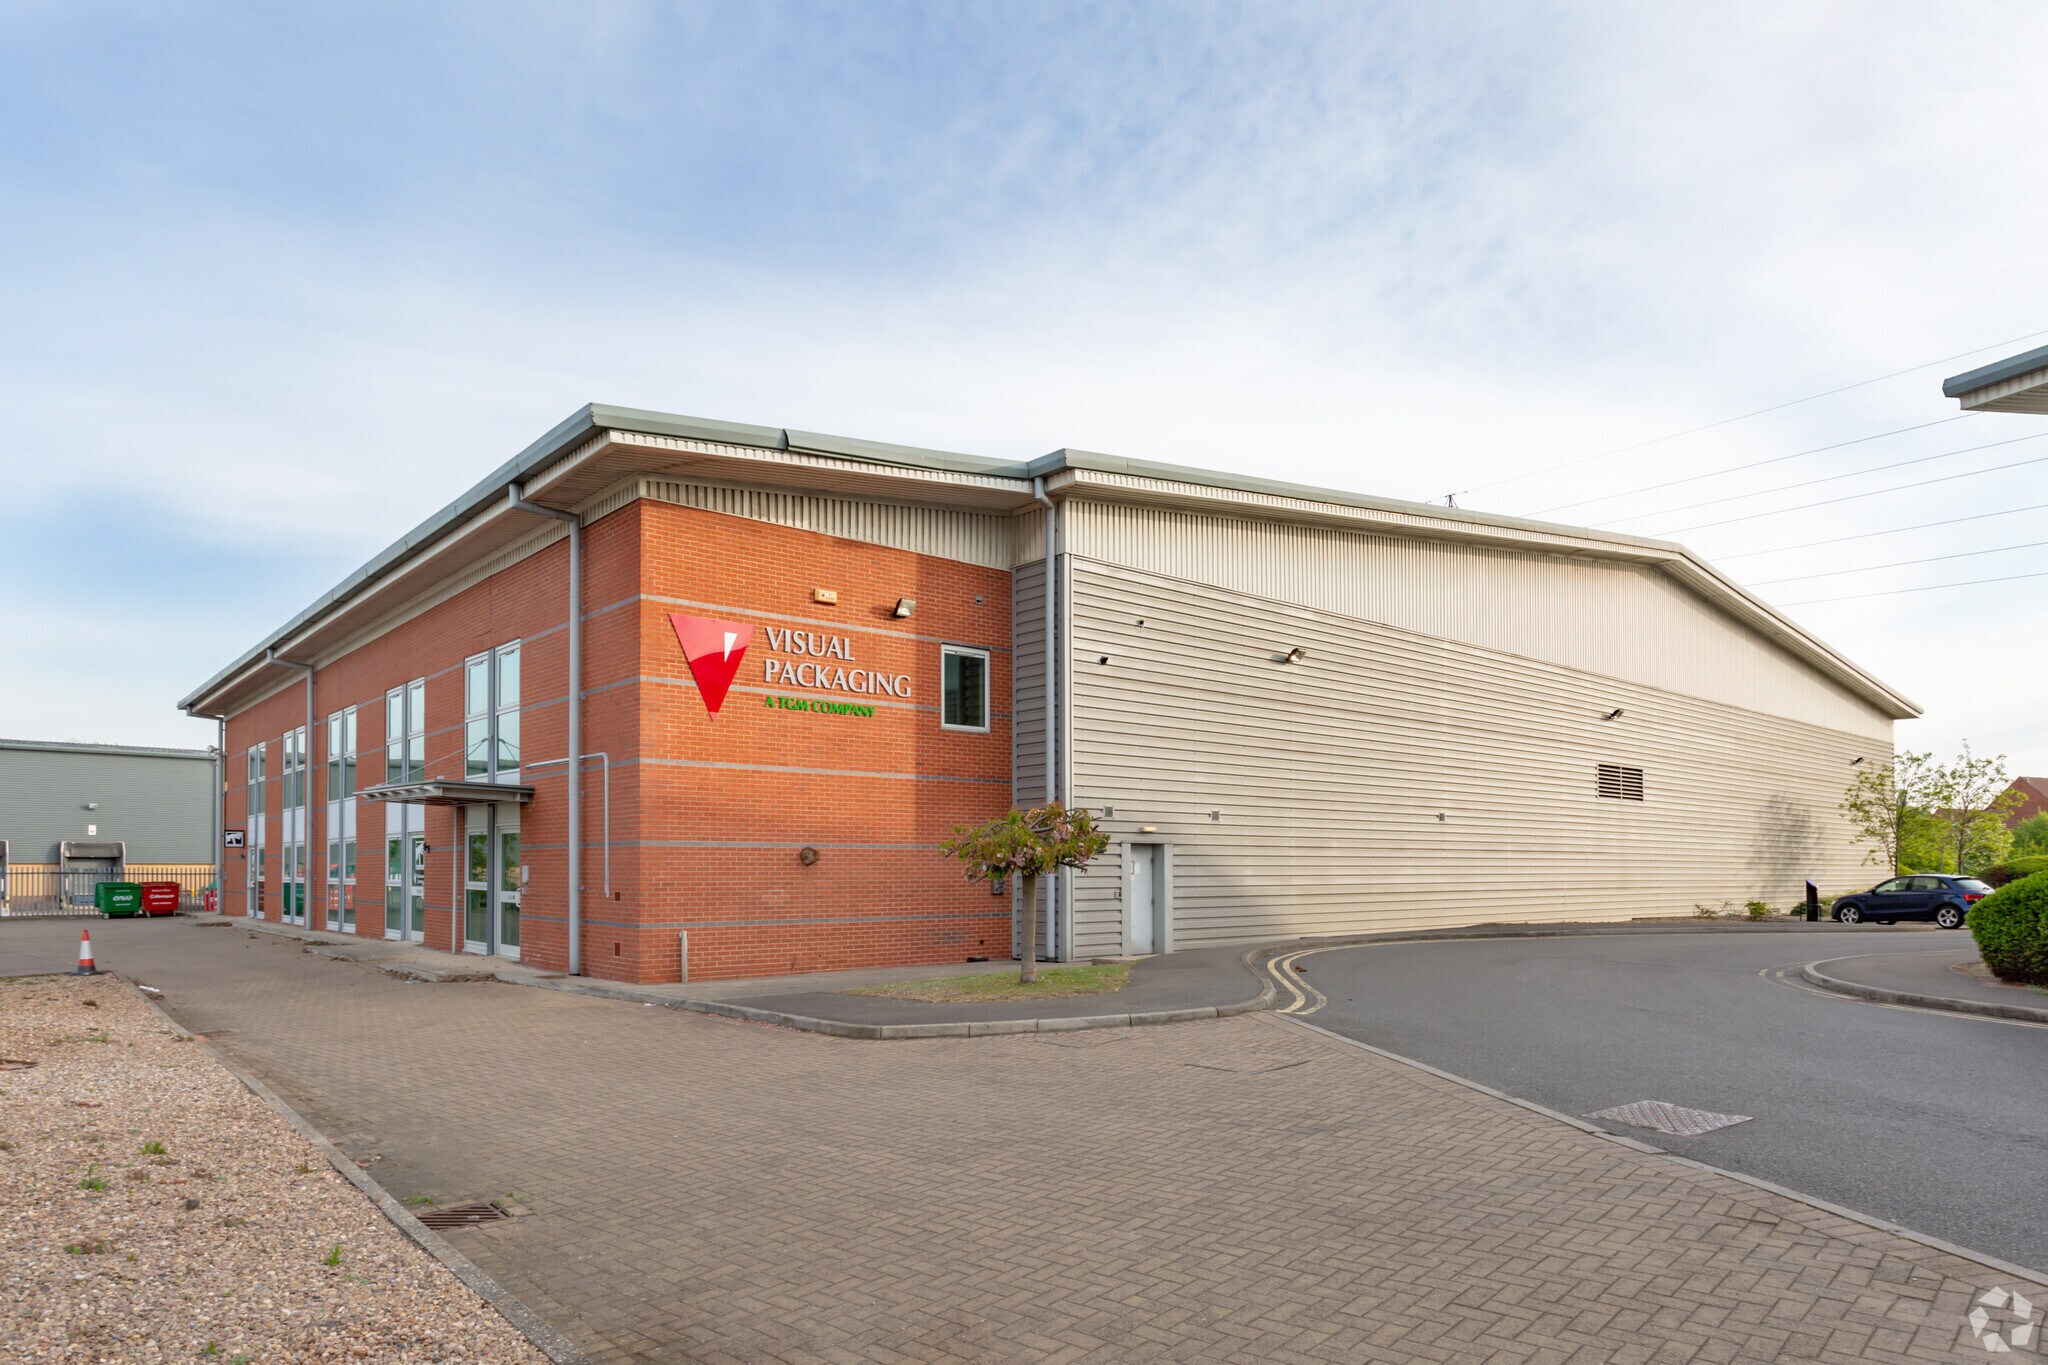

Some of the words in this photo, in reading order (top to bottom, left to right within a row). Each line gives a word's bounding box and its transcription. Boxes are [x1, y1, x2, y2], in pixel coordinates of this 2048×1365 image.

[765, 626, 856, 661] VISUAL
[764, 658, 912, 698] PACKAGING
[764, 695, 775, 708] A
[778, 696, 809, 711] TGM
[811, 700, 876, 717] COMPANY
